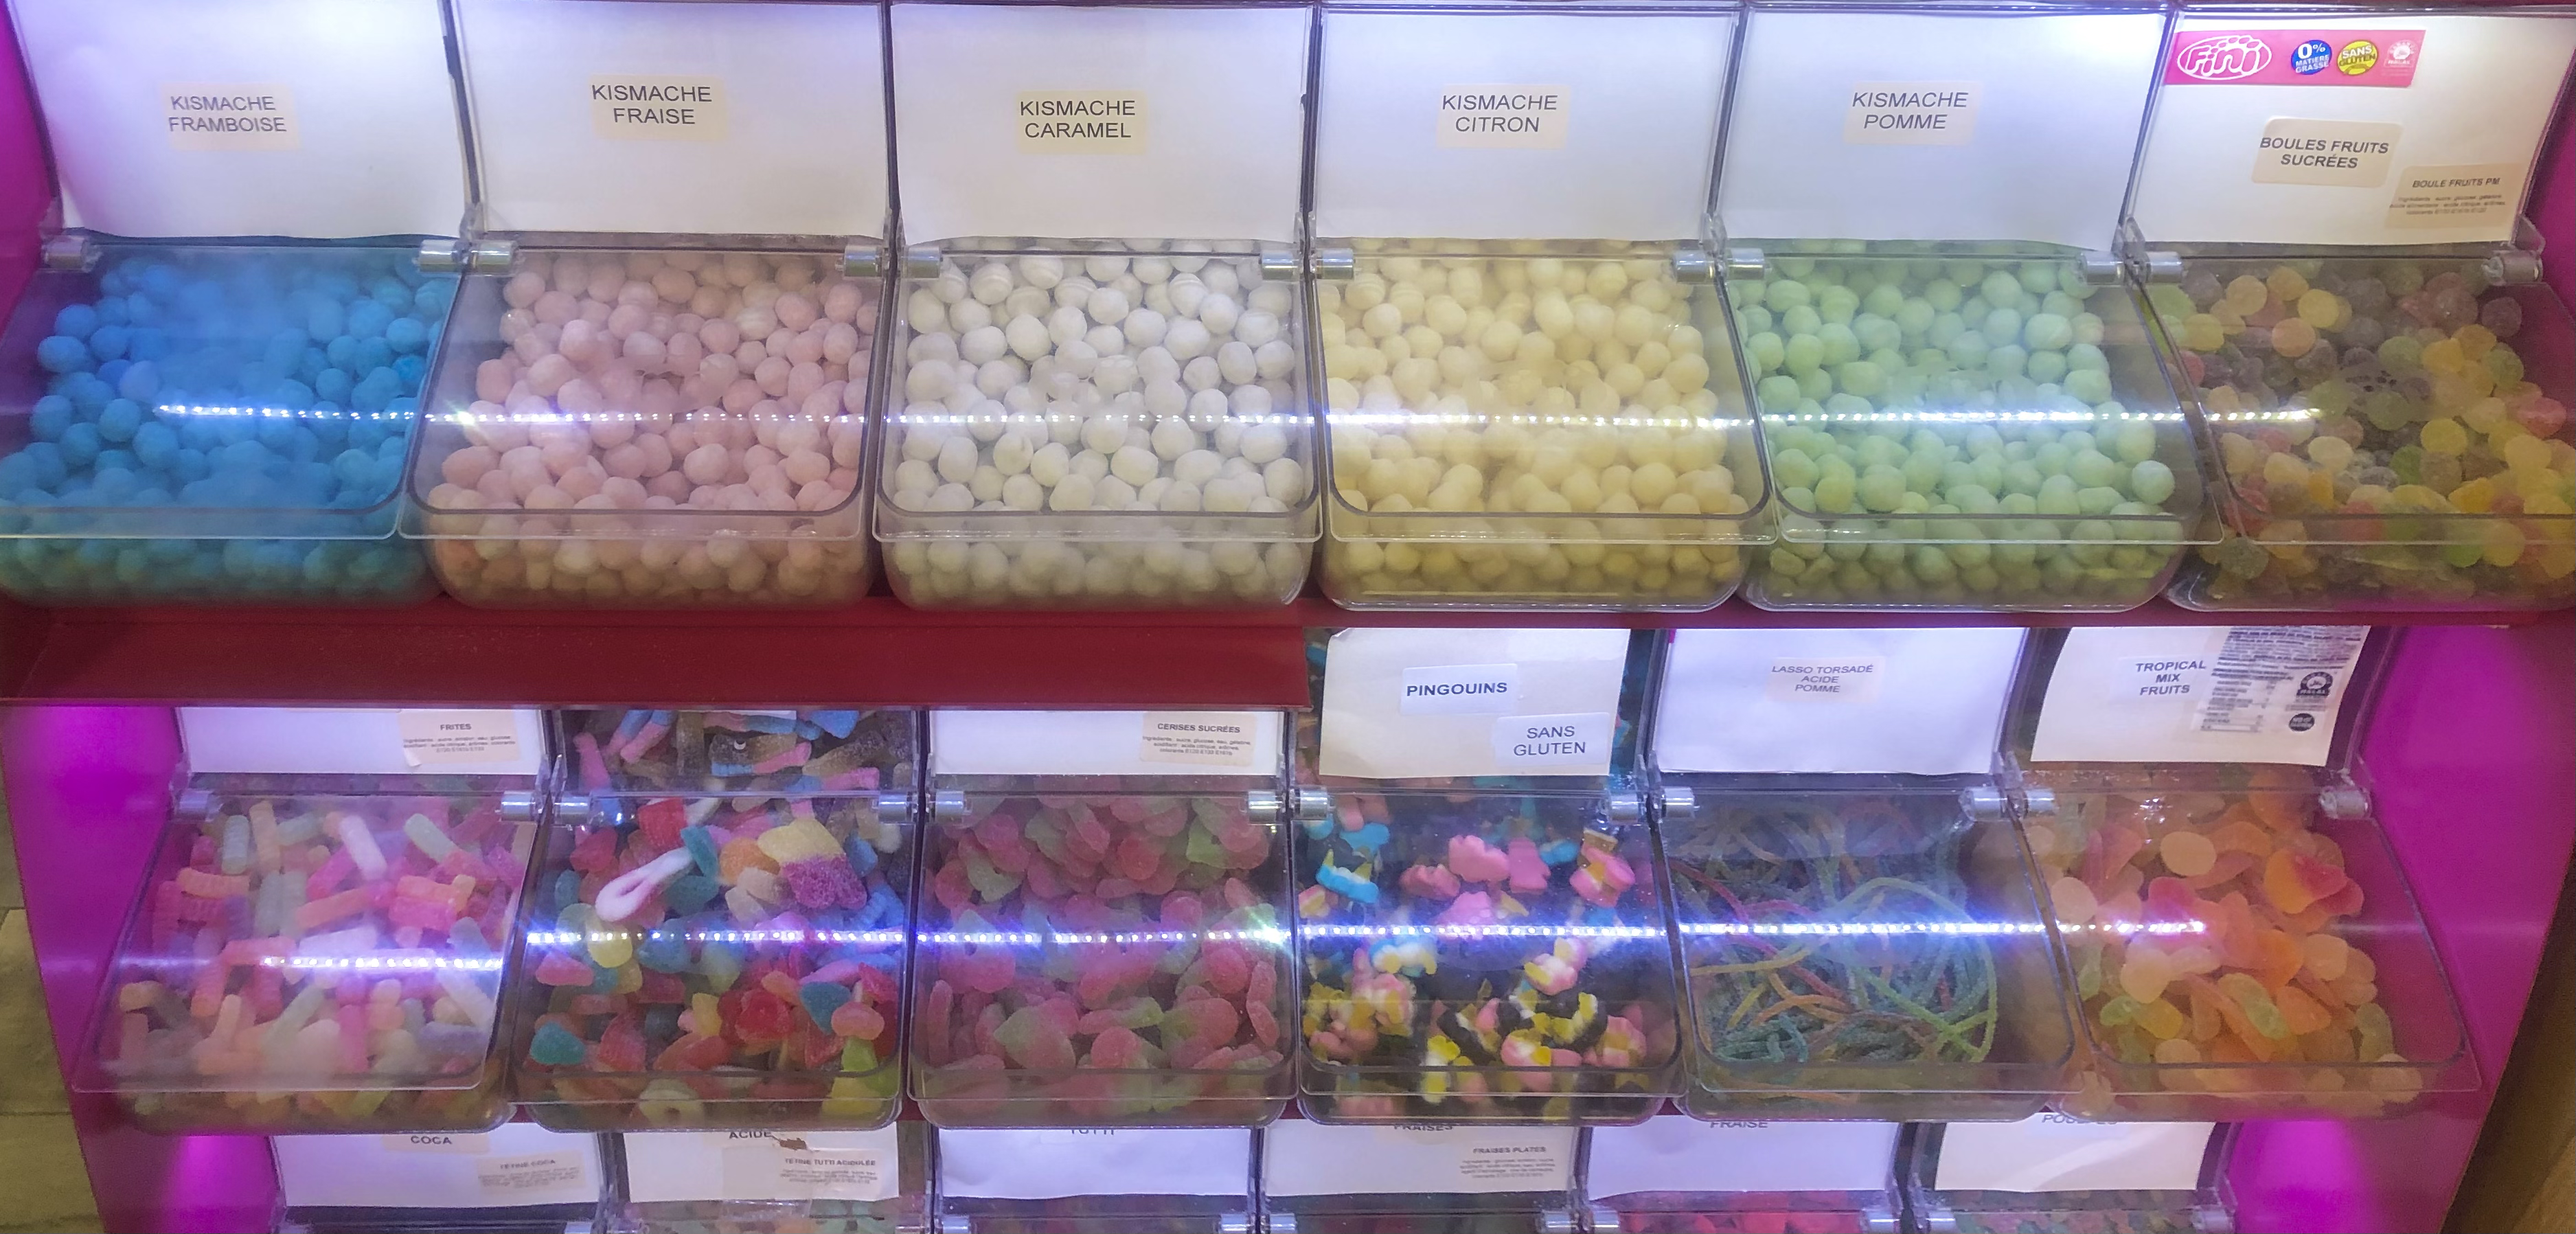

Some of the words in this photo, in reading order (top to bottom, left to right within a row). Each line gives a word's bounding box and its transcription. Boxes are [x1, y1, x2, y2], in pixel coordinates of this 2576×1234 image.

[2181, 37, 2266, 78] Fini
[2298, 43, 2326, 59] 0%
[2342, 44, 2373, 59] SANS
[2295, 61, 2329, 73] GRASSE
[2338, 54, 2375, 67] GLUTEN
[592, 85, 711, 102] KISMACHE
[1853, 92, 1968, 107] KISMACHE
[171, 96, 276, 111] KISMACHE
[1021, 101, 1135, 115] KISMACHE
[1443, 95, 1558, 110] KISMACHE
[614, 108, 695, 124] FRAISE
[1864, 115, 1947, 128] POMME
[169, 117, 286, 132] FRAMBOISE
[1025, 123, 1131, 137] CARAMEL
[1456, 117, 1539, 132] CITRON
[2260, 137, 2326, 151] BOULES
[2331, 141, 2389, 154] FRUITS
[2281, 152, 2358, 168] SUCRÉES
[2449, 179, 2483, 187] FRUITS
[1817, 665, 1873, 674] TORSADÉ
[2136, 661, 2207, 672] TROPICAL
[2156, 674, 2180, 683] MIX
[1407, 683, 1507, 696] PINGOUINS
[2140, 685, 2190, 695] FRUITS
[1527, 726, 1575, 739] SANS
[1514, 742, 1585, 755] GLUTEN
[411, 1136, 452, 1144] COCA
